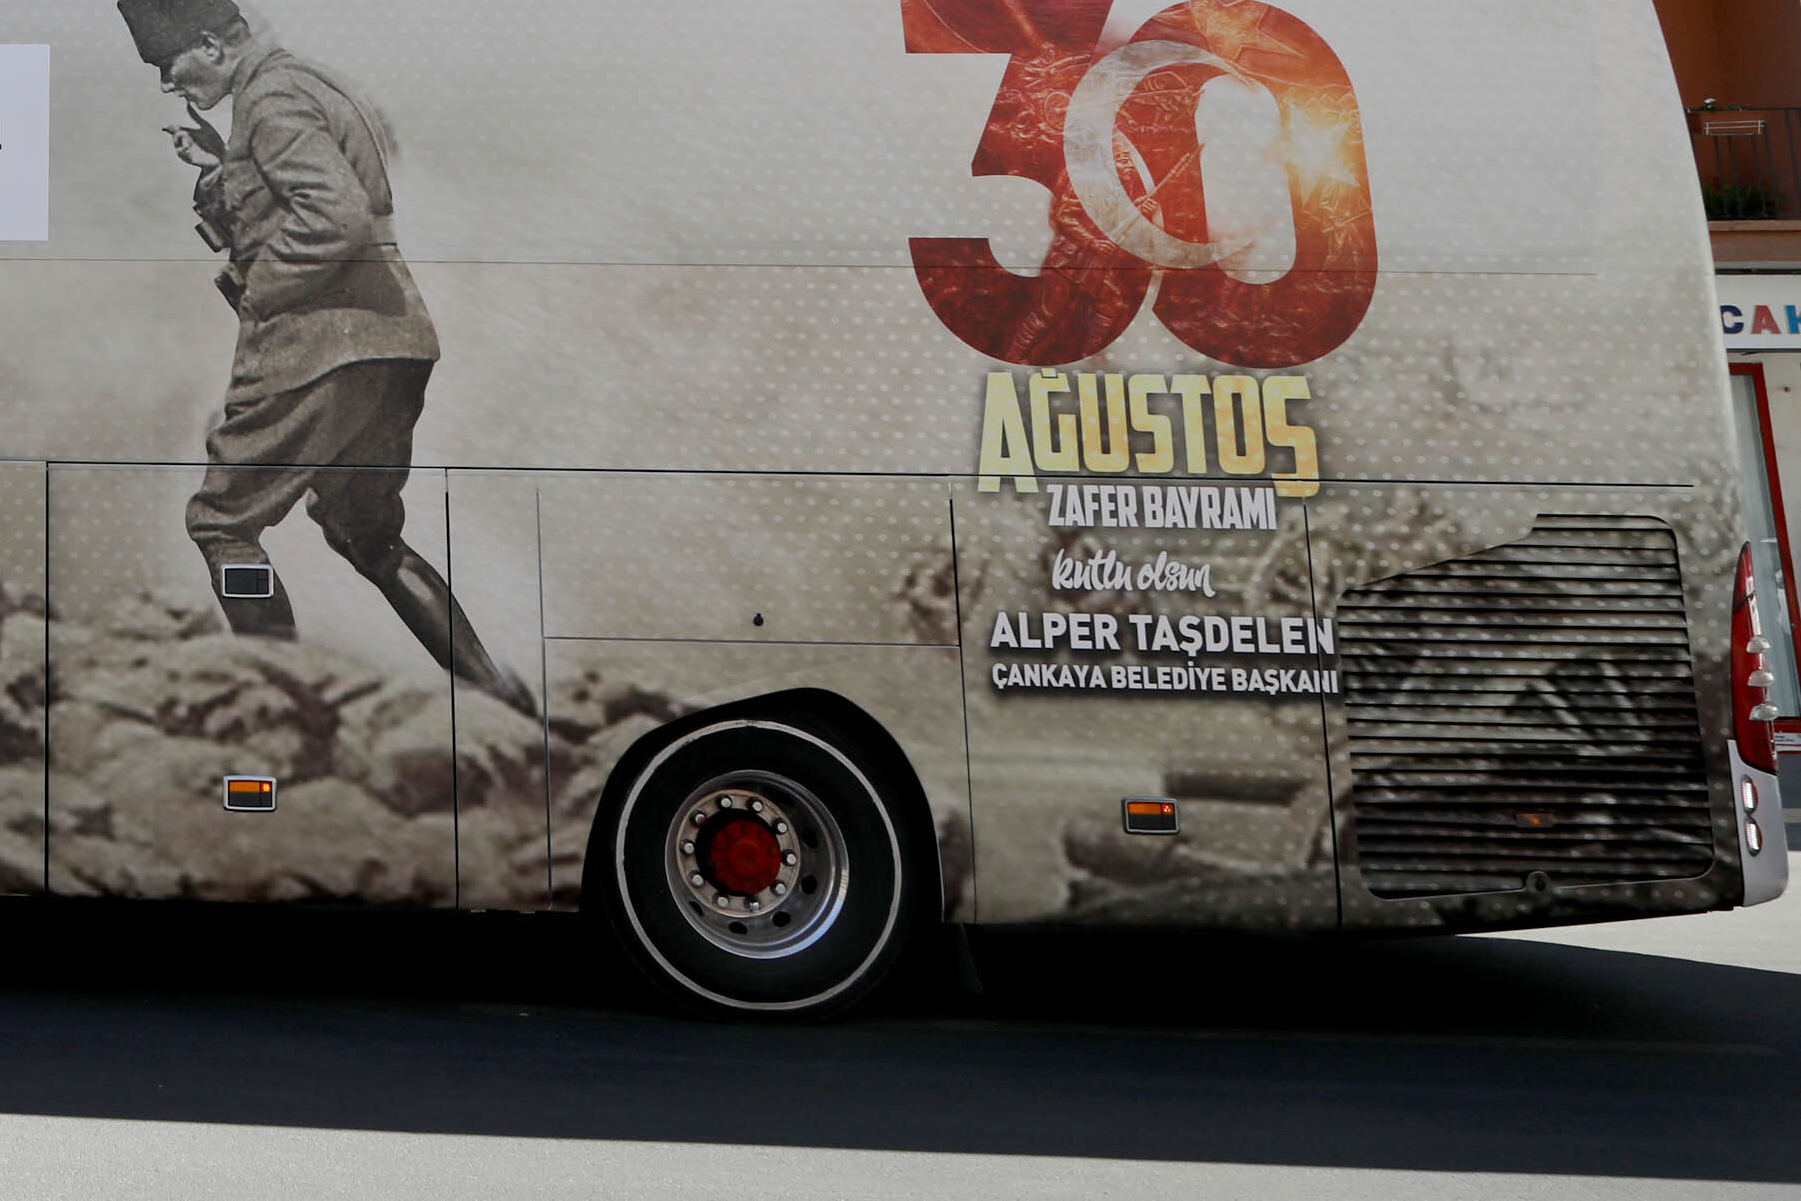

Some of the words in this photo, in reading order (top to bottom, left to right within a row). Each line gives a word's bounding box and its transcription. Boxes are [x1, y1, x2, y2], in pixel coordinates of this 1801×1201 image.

[1047, 484, 1139, 528] ZAFER
[1143, 486, 1278, 530] BAYRAMI
[1052, 548, 1132, 591] kutlu
[1136, 550, 1216, 598] olsun
[990, 612, 1121, 650] ALPER
[1129, 614, 1335, 656] TAŞDELEN
[992, 663, 1107, 691] ÇANKAYA
[1111, 661, 1226, 691] BELEDİYE
[1231, 668, 1339, 696] BAŞKANI
